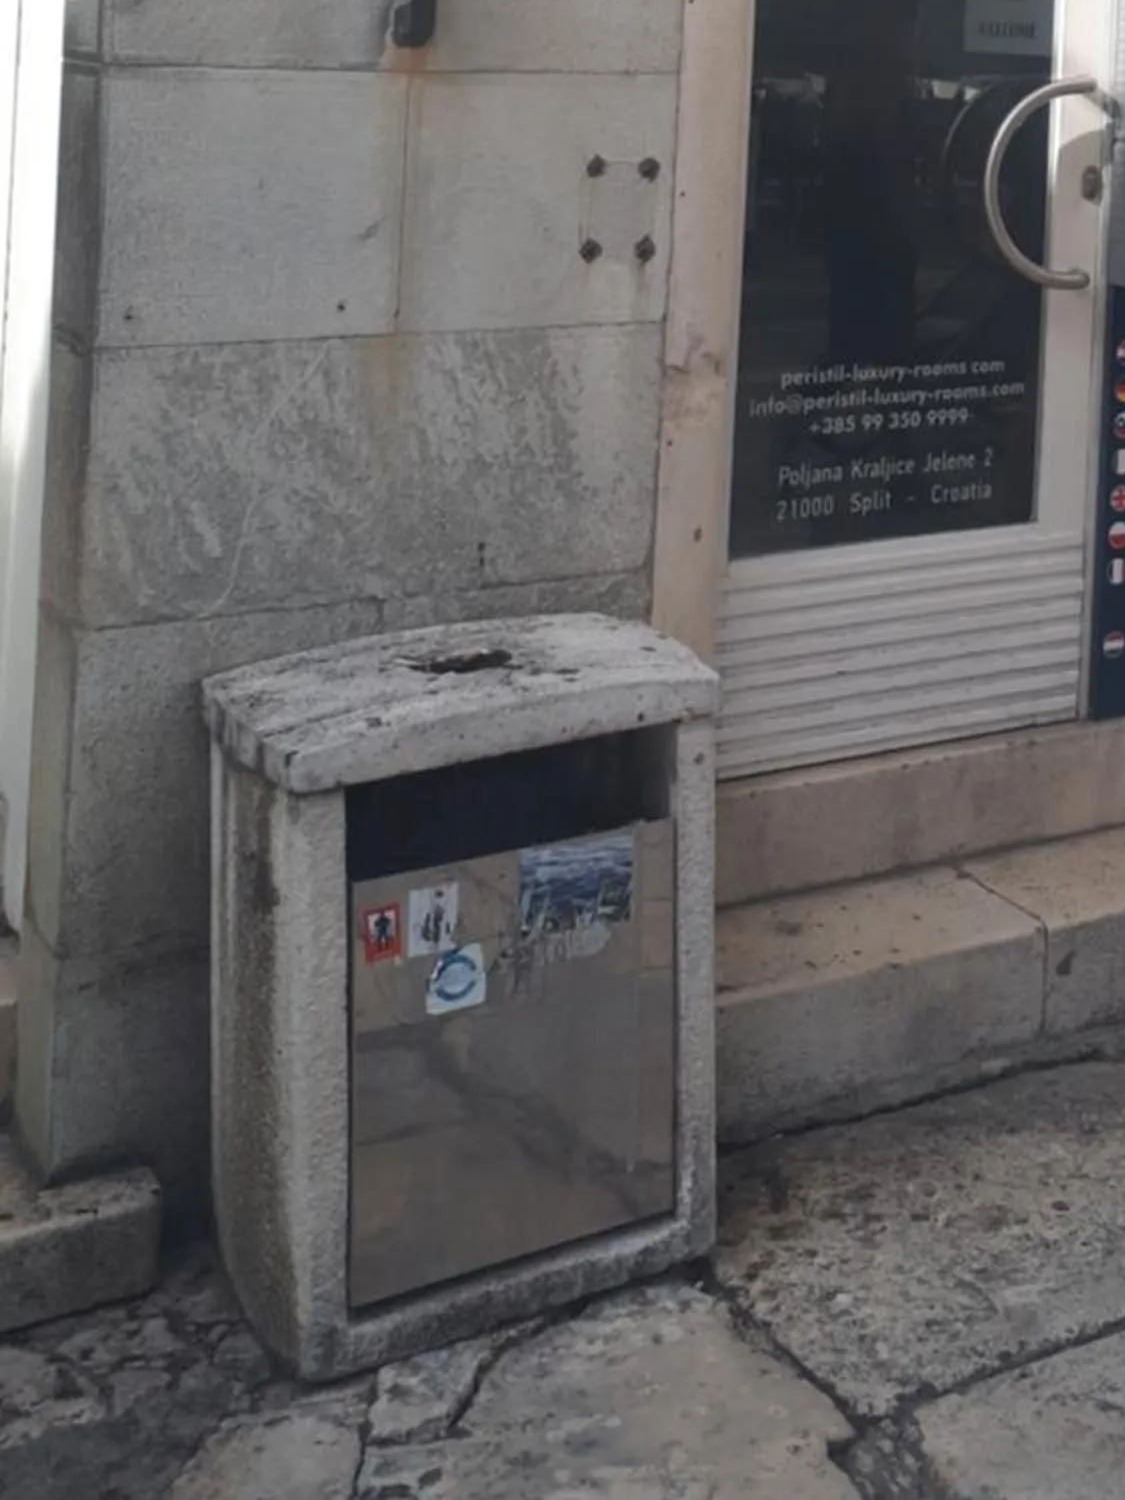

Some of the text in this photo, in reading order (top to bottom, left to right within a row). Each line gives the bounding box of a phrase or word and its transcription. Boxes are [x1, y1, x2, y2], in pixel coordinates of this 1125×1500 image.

[778, 465, 843, 490] Poljana
[850, 457, 916, 483] Kraljice
[776, 495, 835, 521] 21000
[849, 490, 892, 516] Split
[930, 482, 993, 505] Croatia
